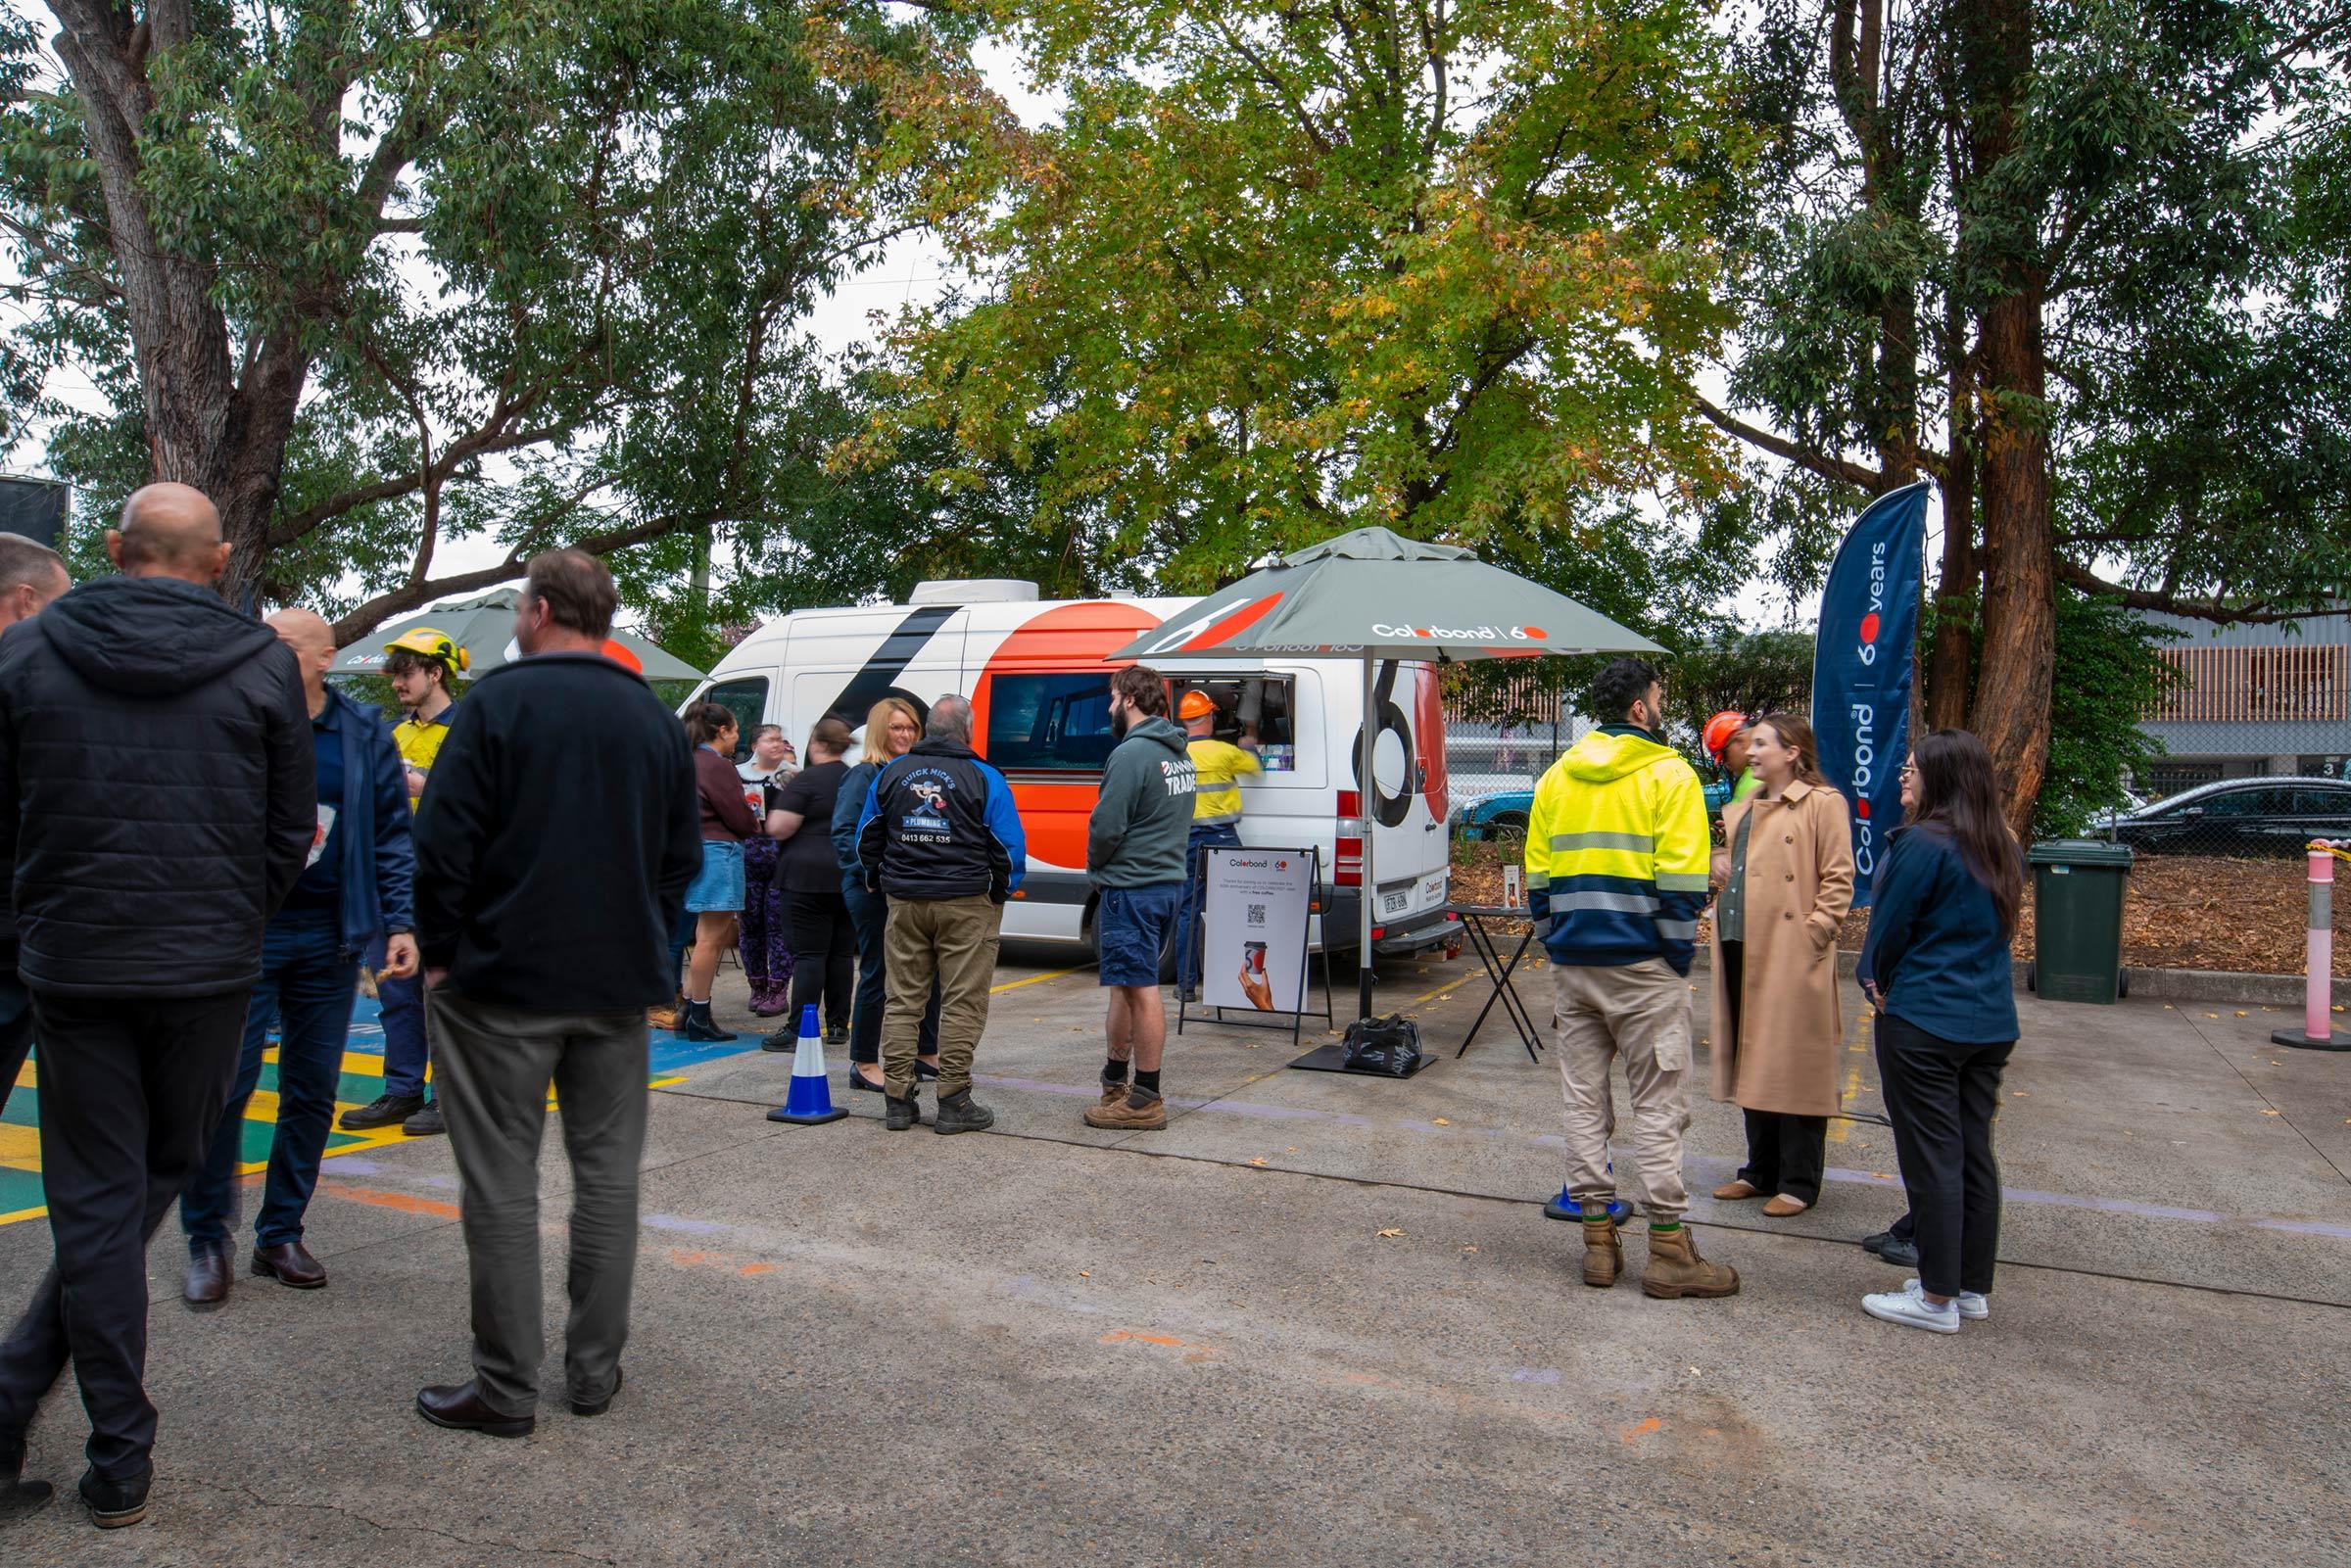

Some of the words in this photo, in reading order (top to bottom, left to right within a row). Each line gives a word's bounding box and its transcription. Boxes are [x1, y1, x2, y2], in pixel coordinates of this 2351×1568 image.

[1869, 542, 1886, 612] years
[901, 768, 929, 786] QUICK
[930, 768, 956, 789] MICK'S
[910, 818, 940, 828] PLUMBING
